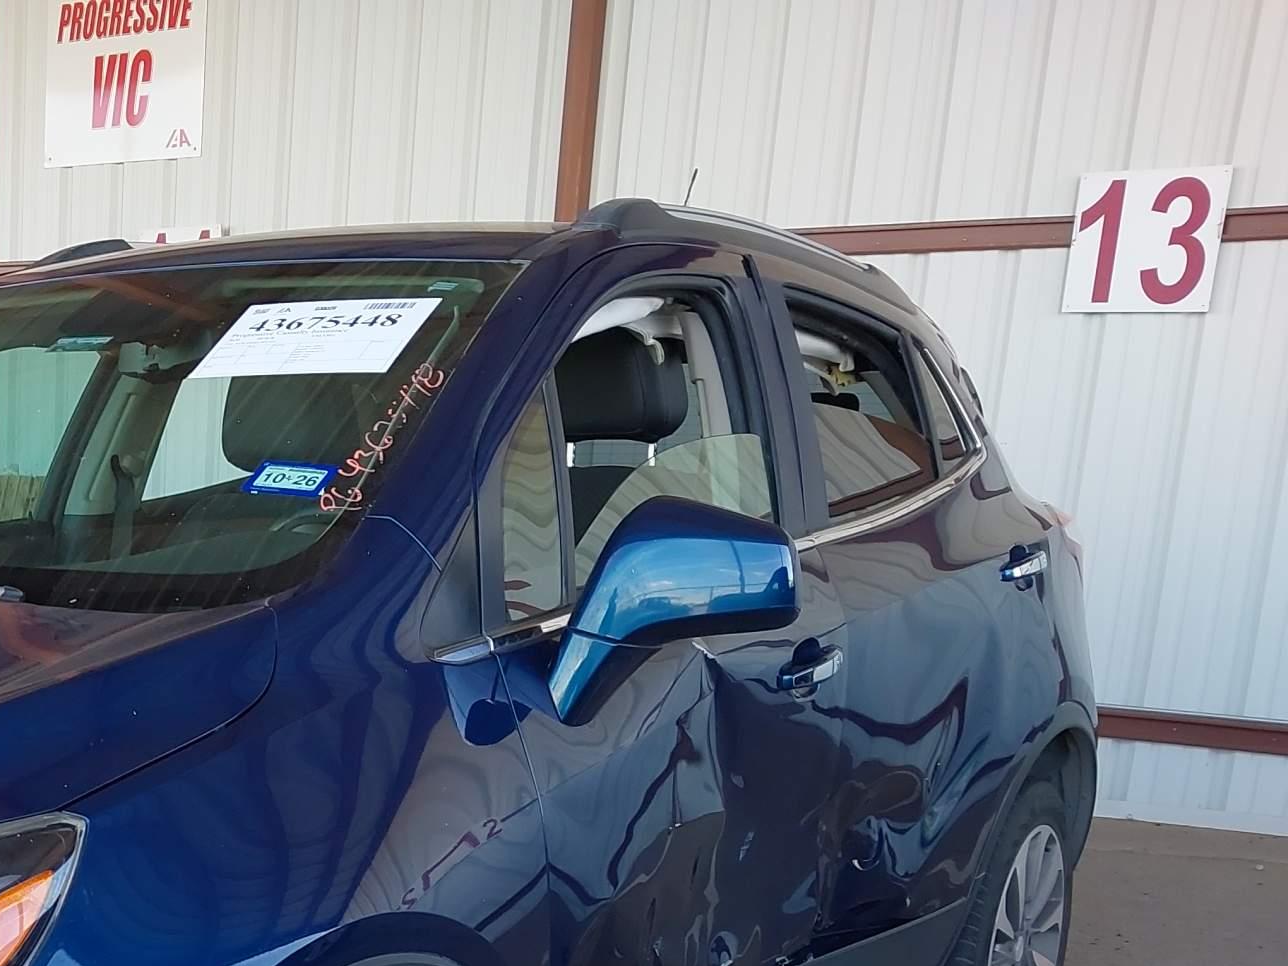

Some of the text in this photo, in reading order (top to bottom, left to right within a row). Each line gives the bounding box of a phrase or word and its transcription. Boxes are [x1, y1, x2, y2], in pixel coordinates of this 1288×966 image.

[57, 0, 192, 43] PROGRESSIVE
[92, 49, 153, 129] VIC
[1079, 176, 1211, 305] 13
[249, 312, 403, 331] 43675448
